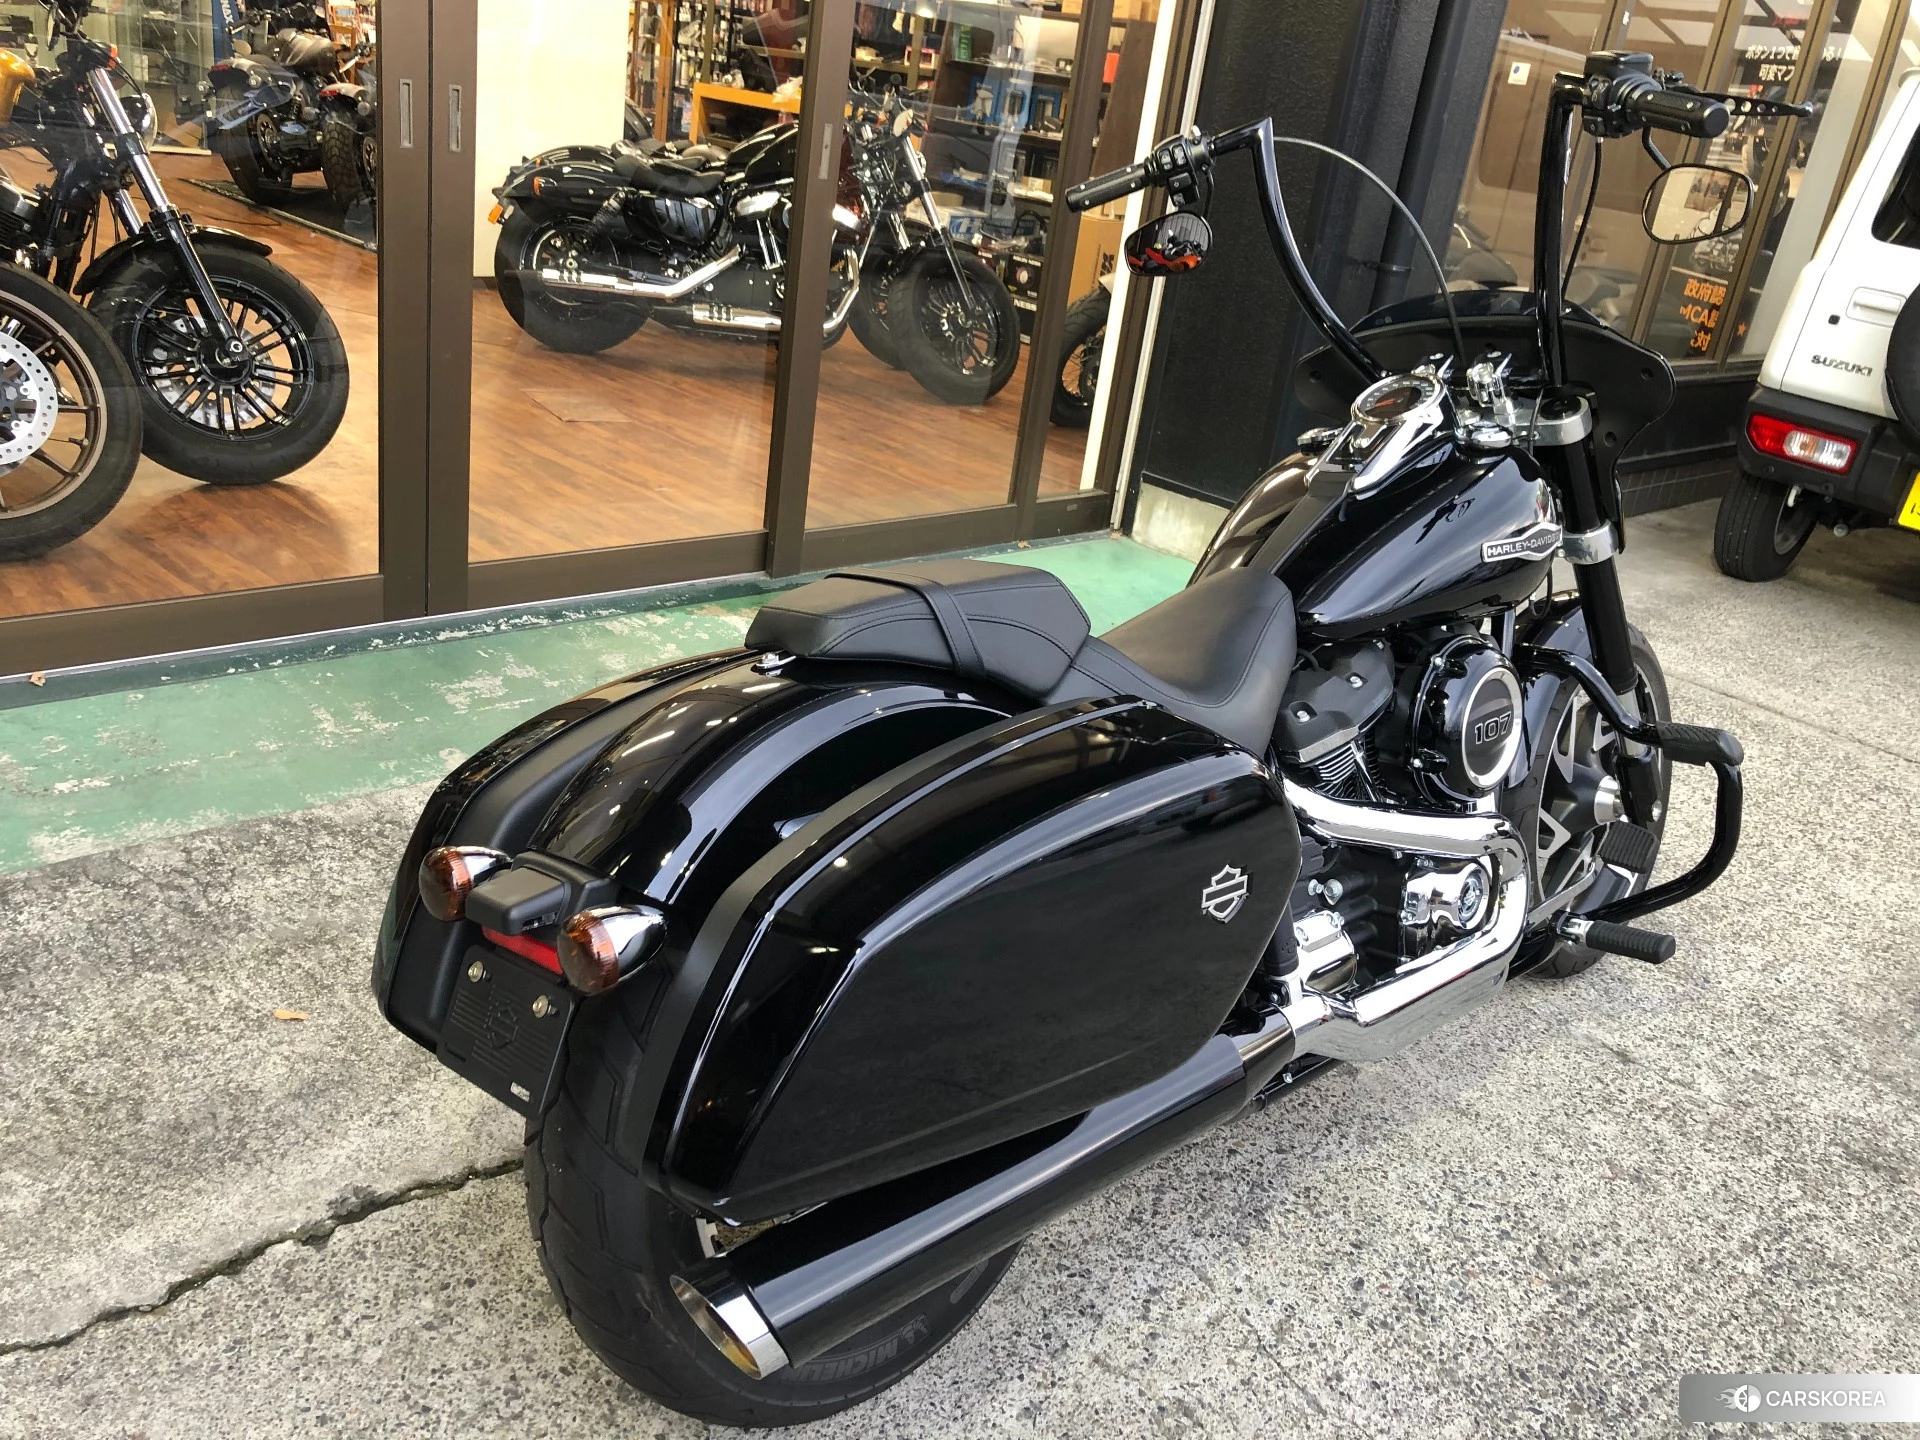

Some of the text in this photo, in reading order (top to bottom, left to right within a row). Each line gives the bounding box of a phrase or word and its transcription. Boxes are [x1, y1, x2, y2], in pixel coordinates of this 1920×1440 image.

[1811, 354, 1873, 377] SUZUKI
[1487, 531, 1560, 557] HARLEY-DAVIDS
[1474, 710, 1512, 745] 107
